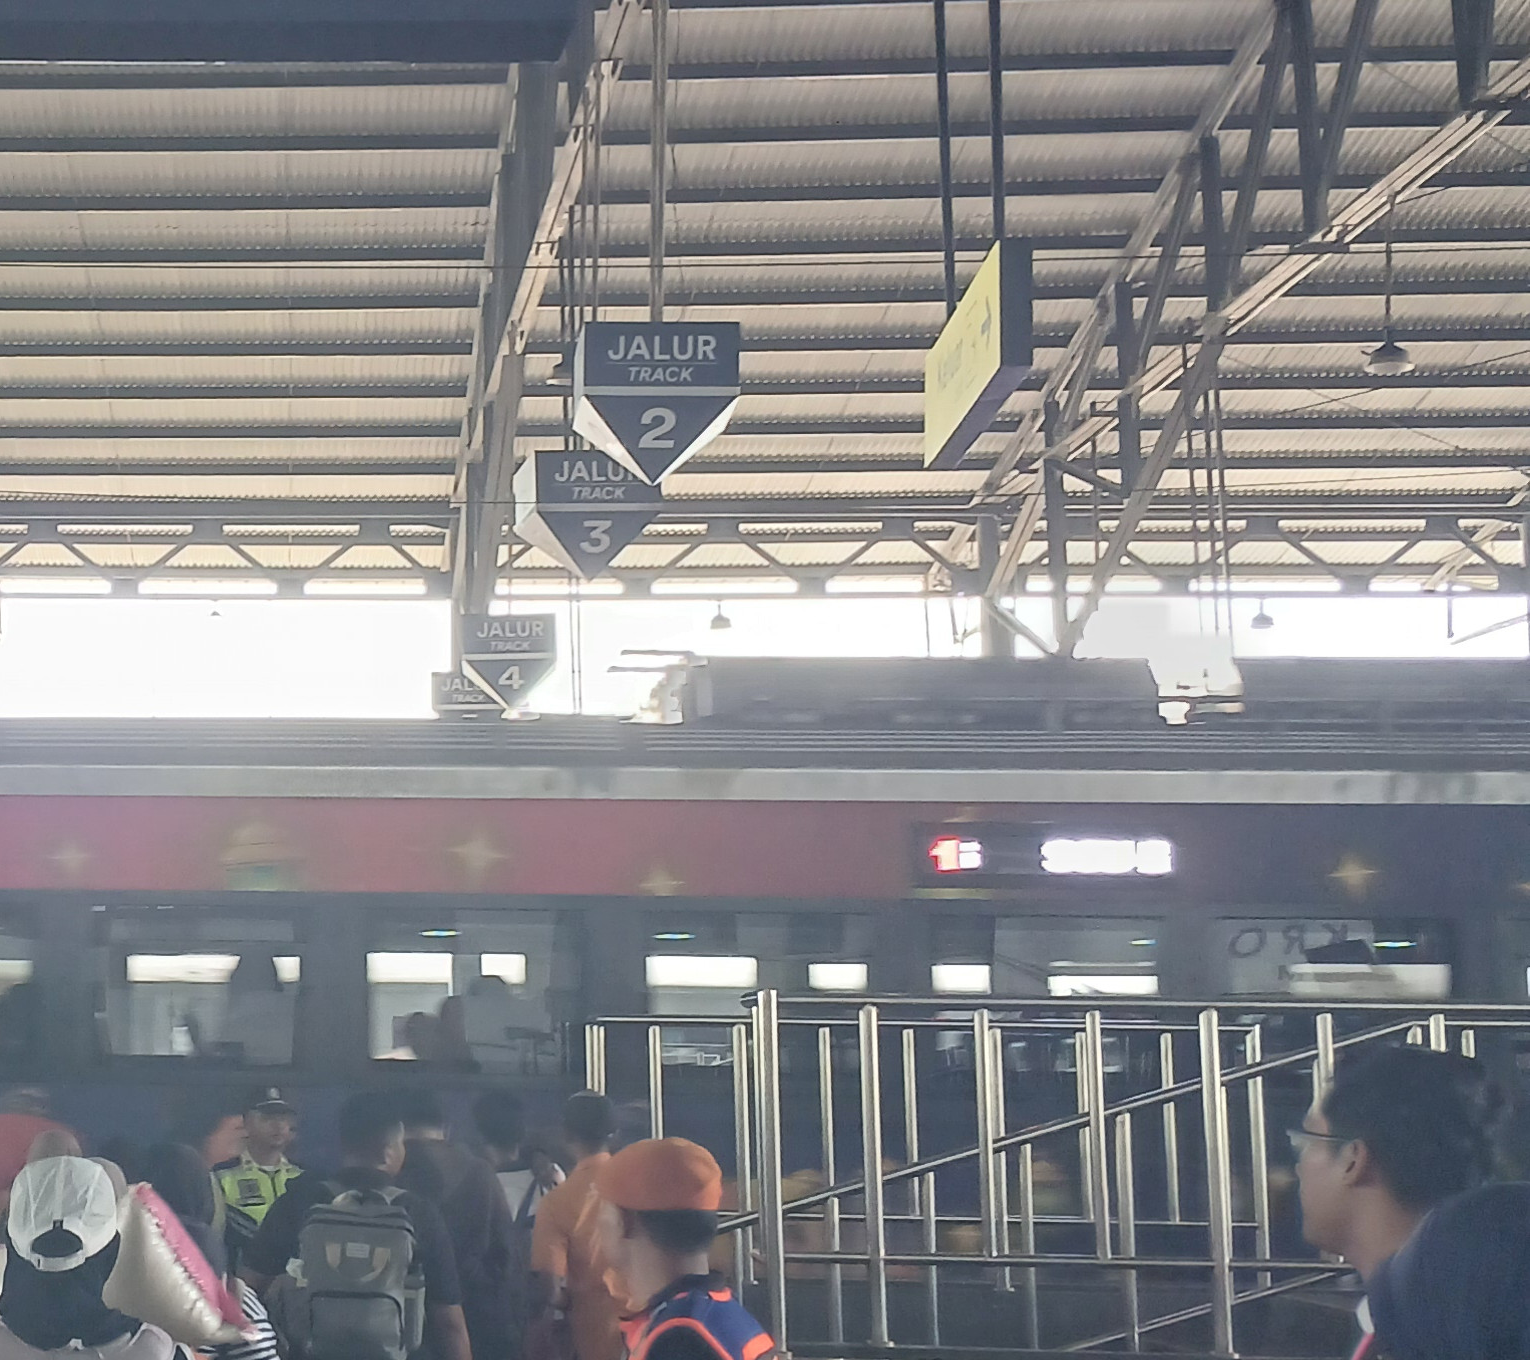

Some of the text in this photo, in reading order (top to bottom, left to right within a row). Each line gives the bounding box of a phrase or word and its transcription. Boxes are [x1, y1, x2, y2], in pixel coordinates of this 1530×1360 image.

[607, 335, 717, 361] JALUR
[627, 366, 694, 382] TRACK
[638, 407, 677, 449] 2
[572, 486, 626, 500] TRACK
[579, 519, 612, 554] 3
[477, 621, 544, 638] JALUR
[490, 640, 531, 652] TRACK
[441, 677, 481, 692] JAL
[498, 666, 524, 690] 4
